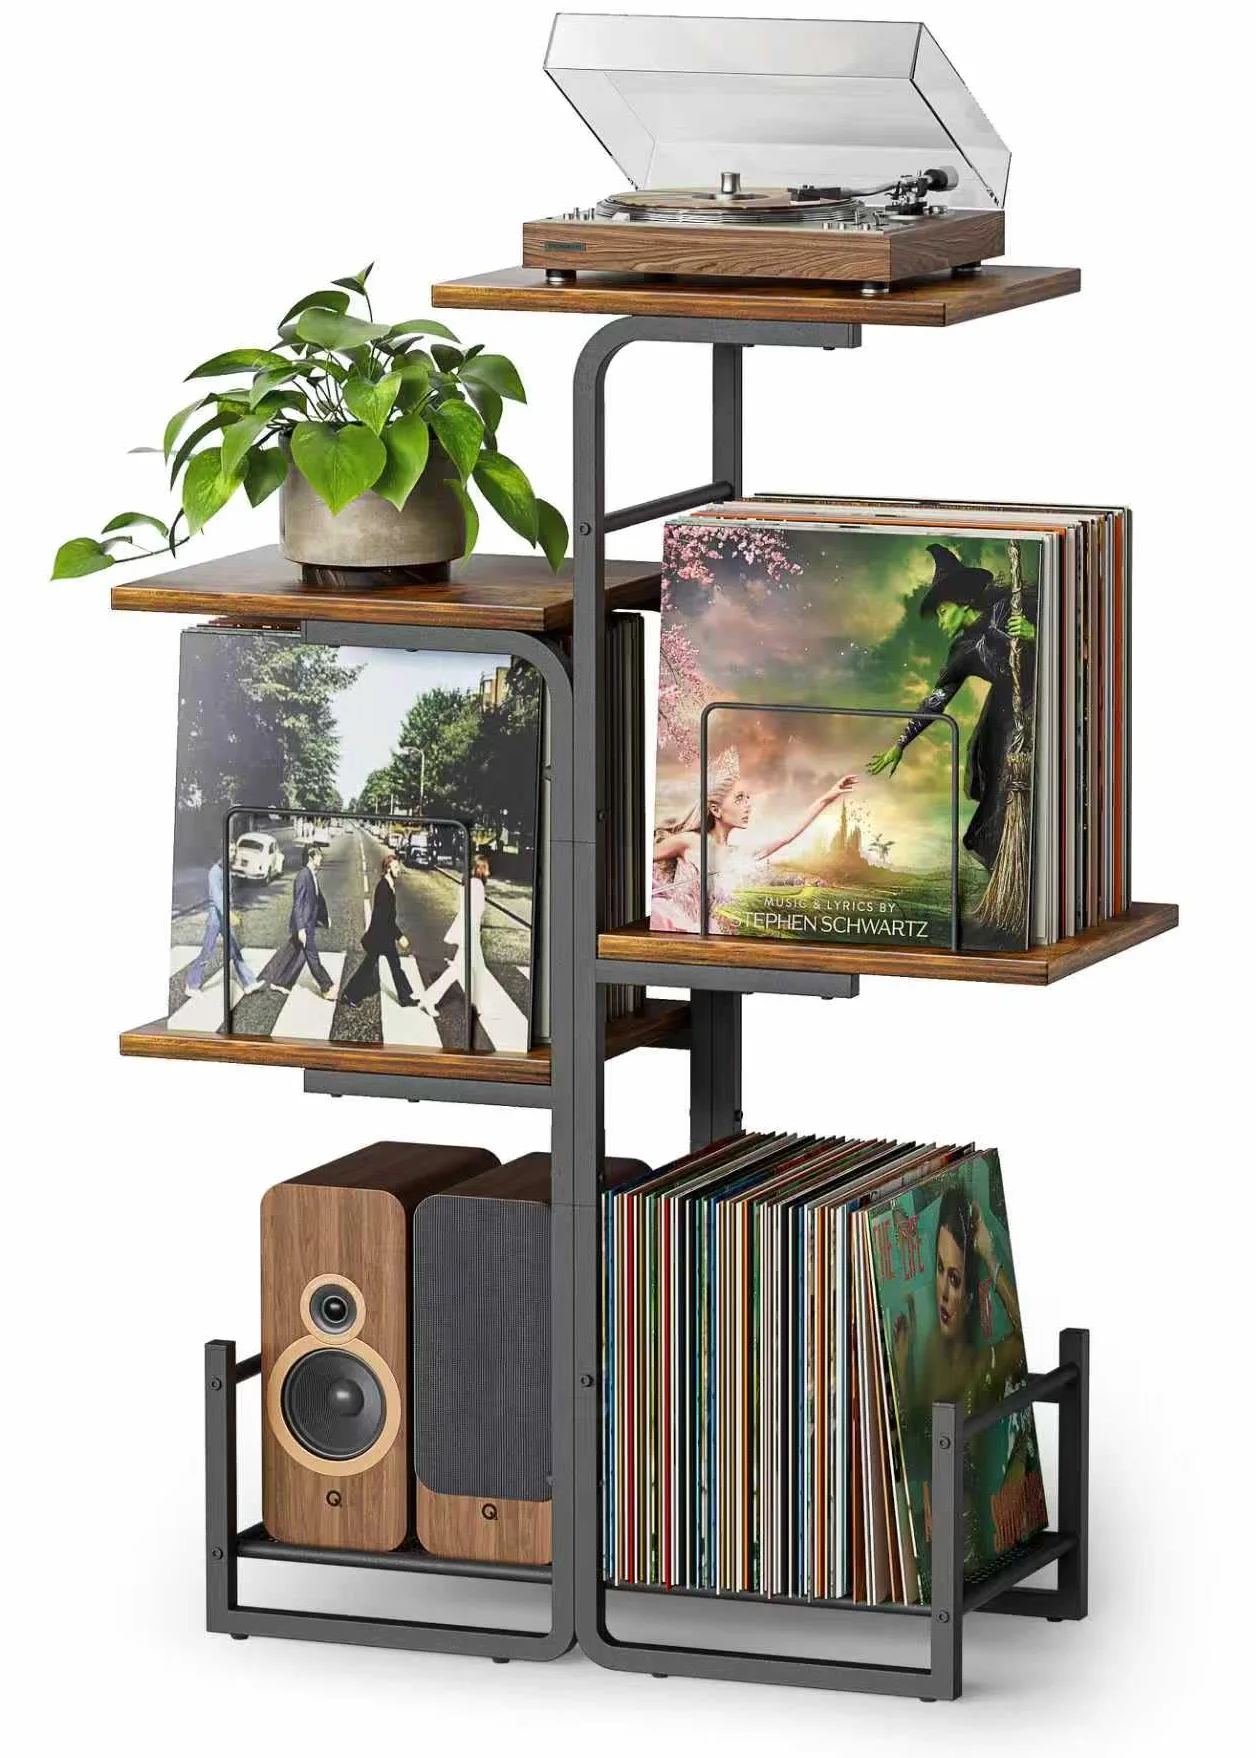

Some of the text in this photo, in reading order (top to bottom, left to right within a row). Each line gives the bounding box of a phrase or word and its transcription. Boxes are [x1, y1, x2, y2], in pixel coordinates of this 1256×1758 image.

[764, 896, 897, 913] MUSIC & LYRICS BY
[731, 911, 929, 938] STEPHEN SCHWARTZ
[326, 1490, 342, 1508] Q
[482, 1503, 498, 1521] Q
